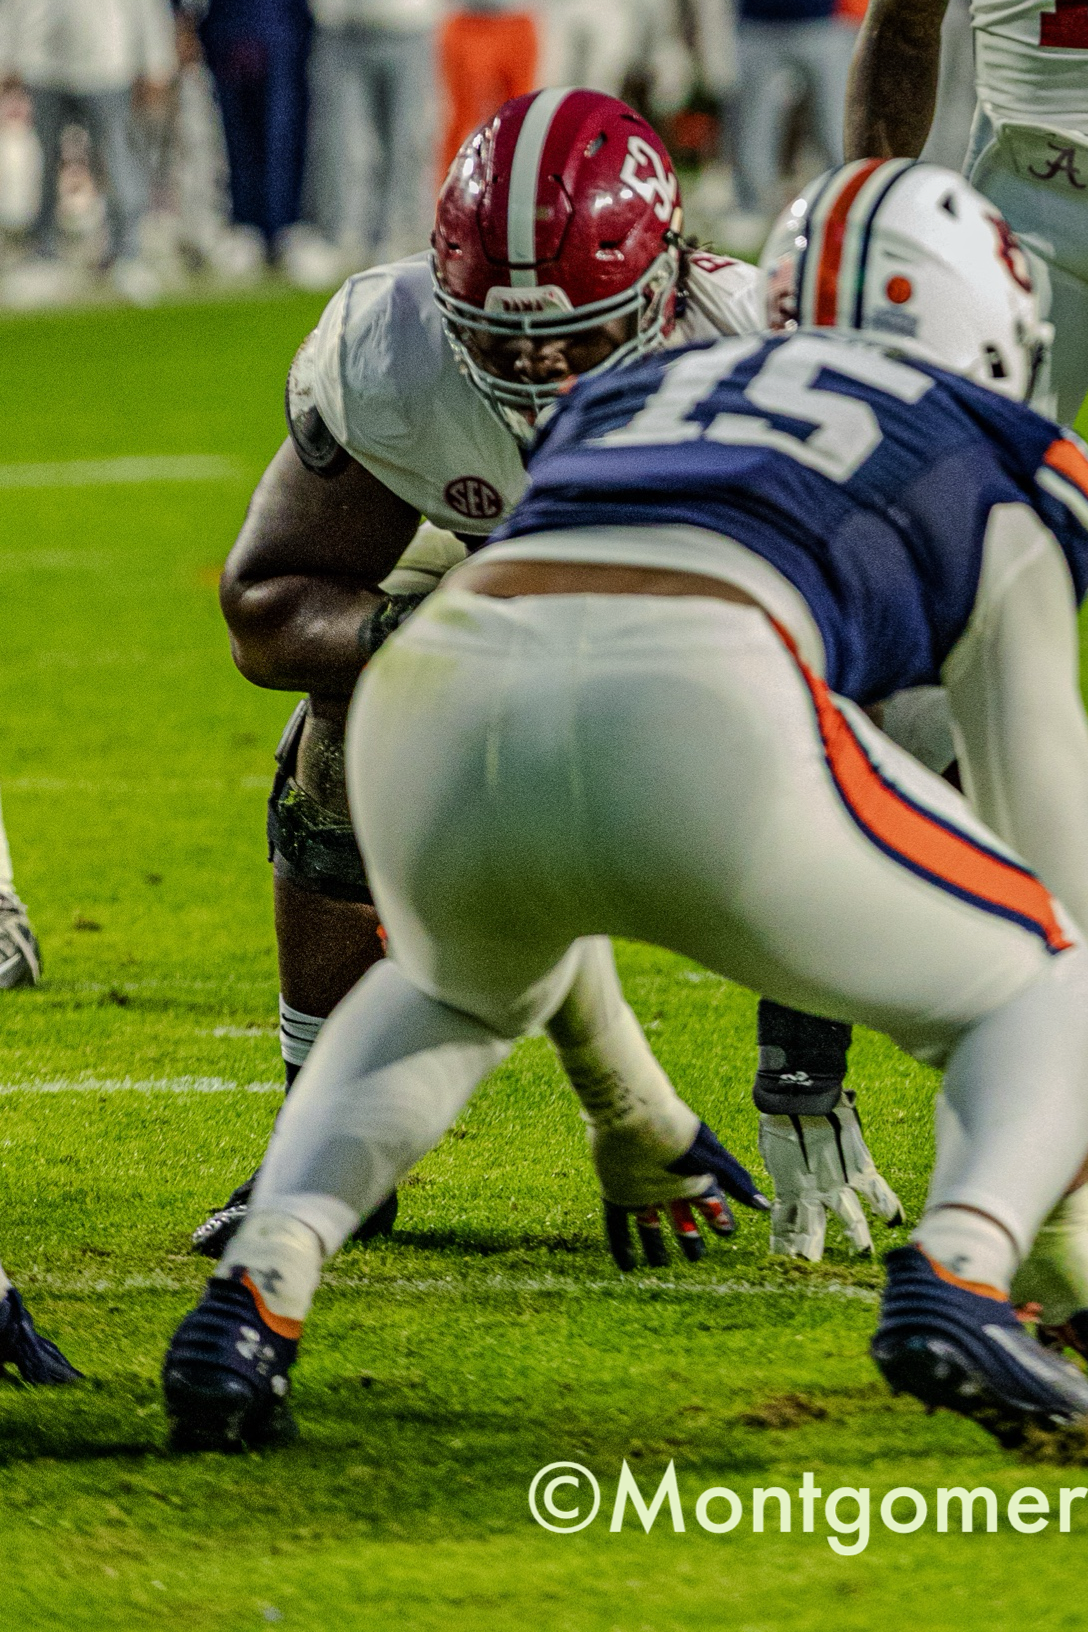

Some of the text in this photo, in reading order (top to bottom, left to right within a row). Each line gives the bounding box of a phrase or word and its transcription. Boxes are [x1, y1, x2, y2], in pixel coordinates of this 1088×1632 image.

[620, 136, 677, 222] 52
[1027, 141, 1087, 190] A
[583, 336, 935, 484] 15
[447, 478, 500, 517] SEC
